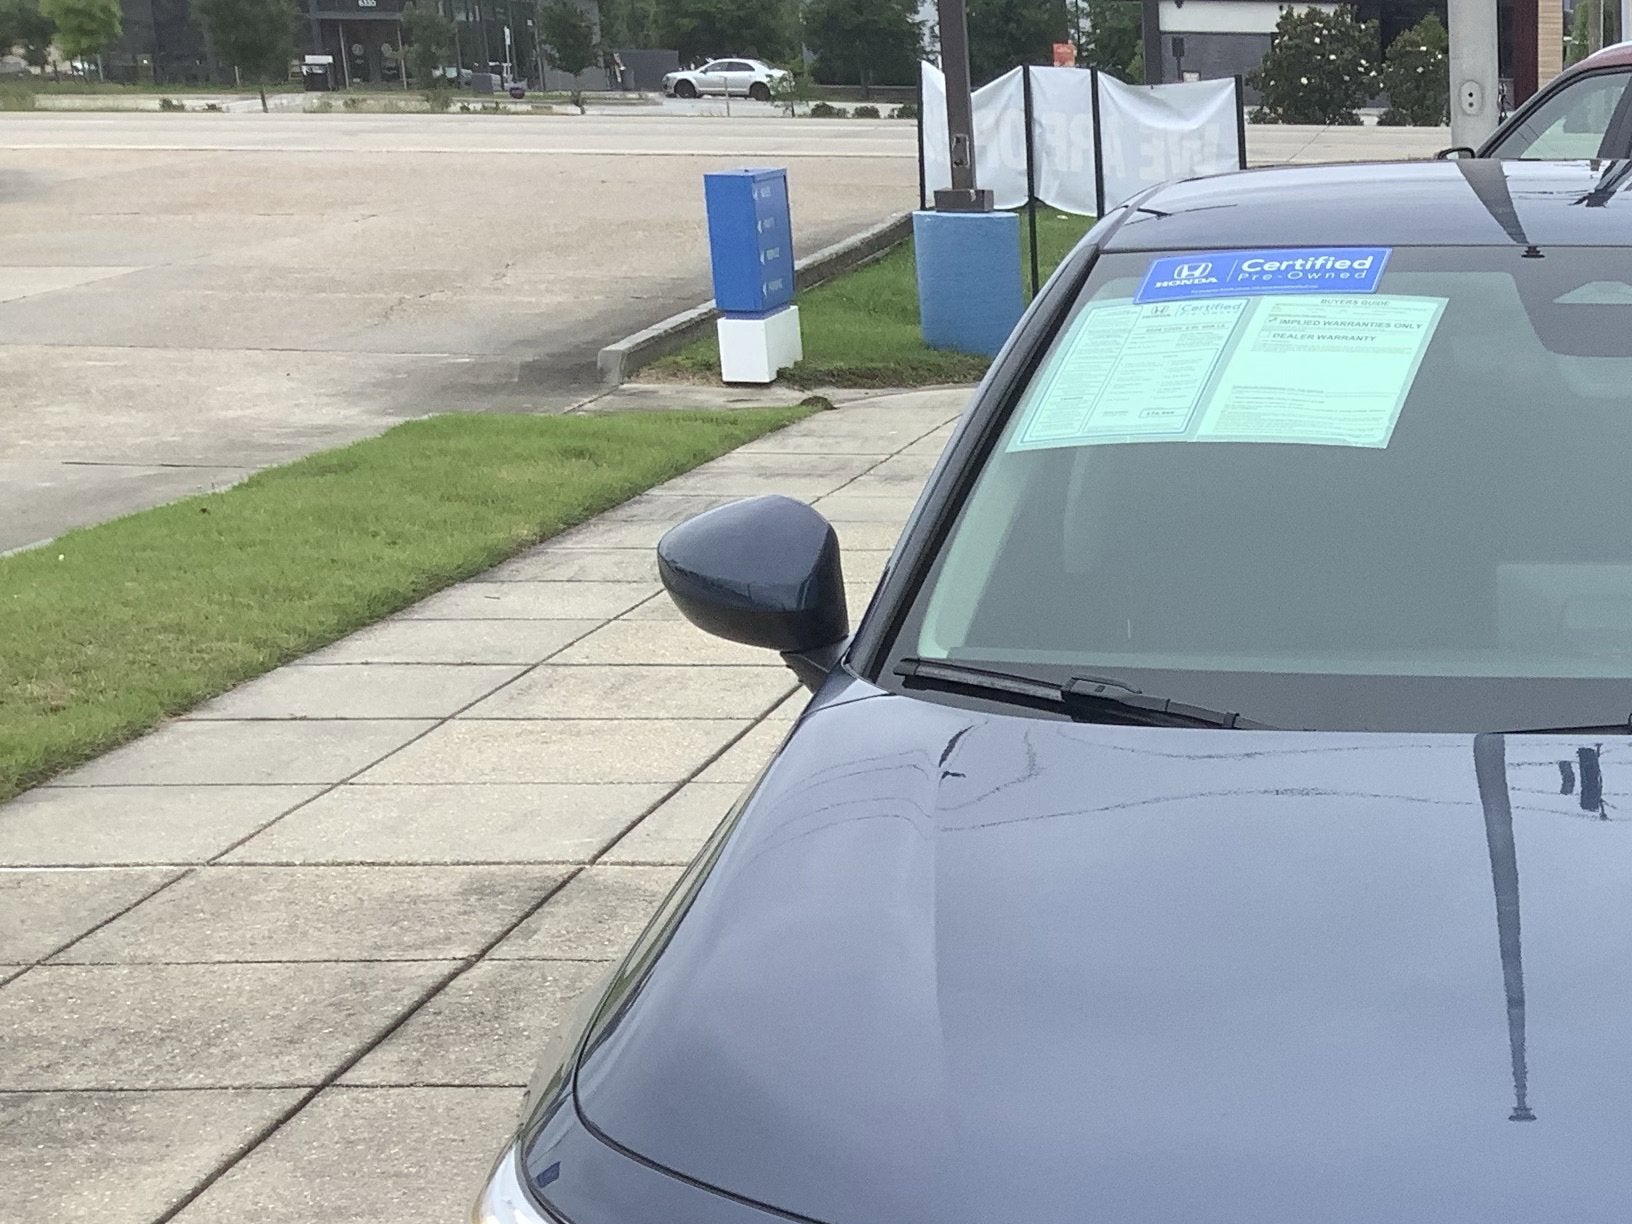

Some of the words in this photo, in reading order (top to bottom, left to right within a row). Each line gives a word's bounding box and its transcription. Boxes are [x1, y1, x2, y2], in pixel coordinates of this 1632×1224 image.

[1241, 255, 1375, 272] Certified
[1153, 277, 1218, 288] HONDA
[1324, 320, 1391, 329] WARRANTIES
[1317, 334, 1377, 342] WARRANTY
